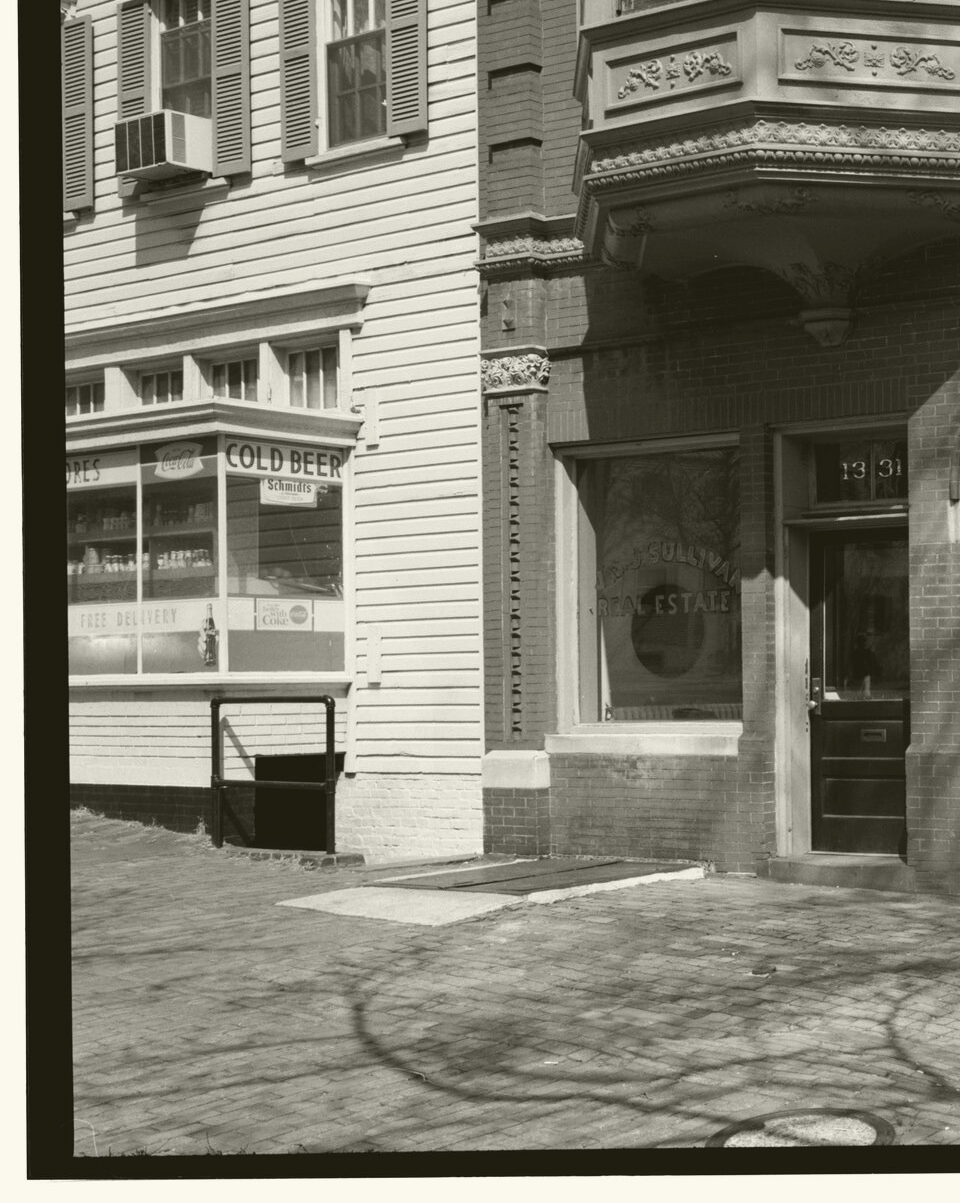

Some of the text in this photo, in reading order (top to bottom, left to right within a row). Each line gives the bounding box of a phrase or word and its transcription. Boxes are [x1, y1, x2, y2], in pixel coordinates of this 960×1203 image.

[226, 443, 341, 478] COLD BEER
[598, 590, 730, 617] REAL ESTATE
[80, 608, 177, 628] FREE DELIVERY
[262, 614, 289, 626] Coke
